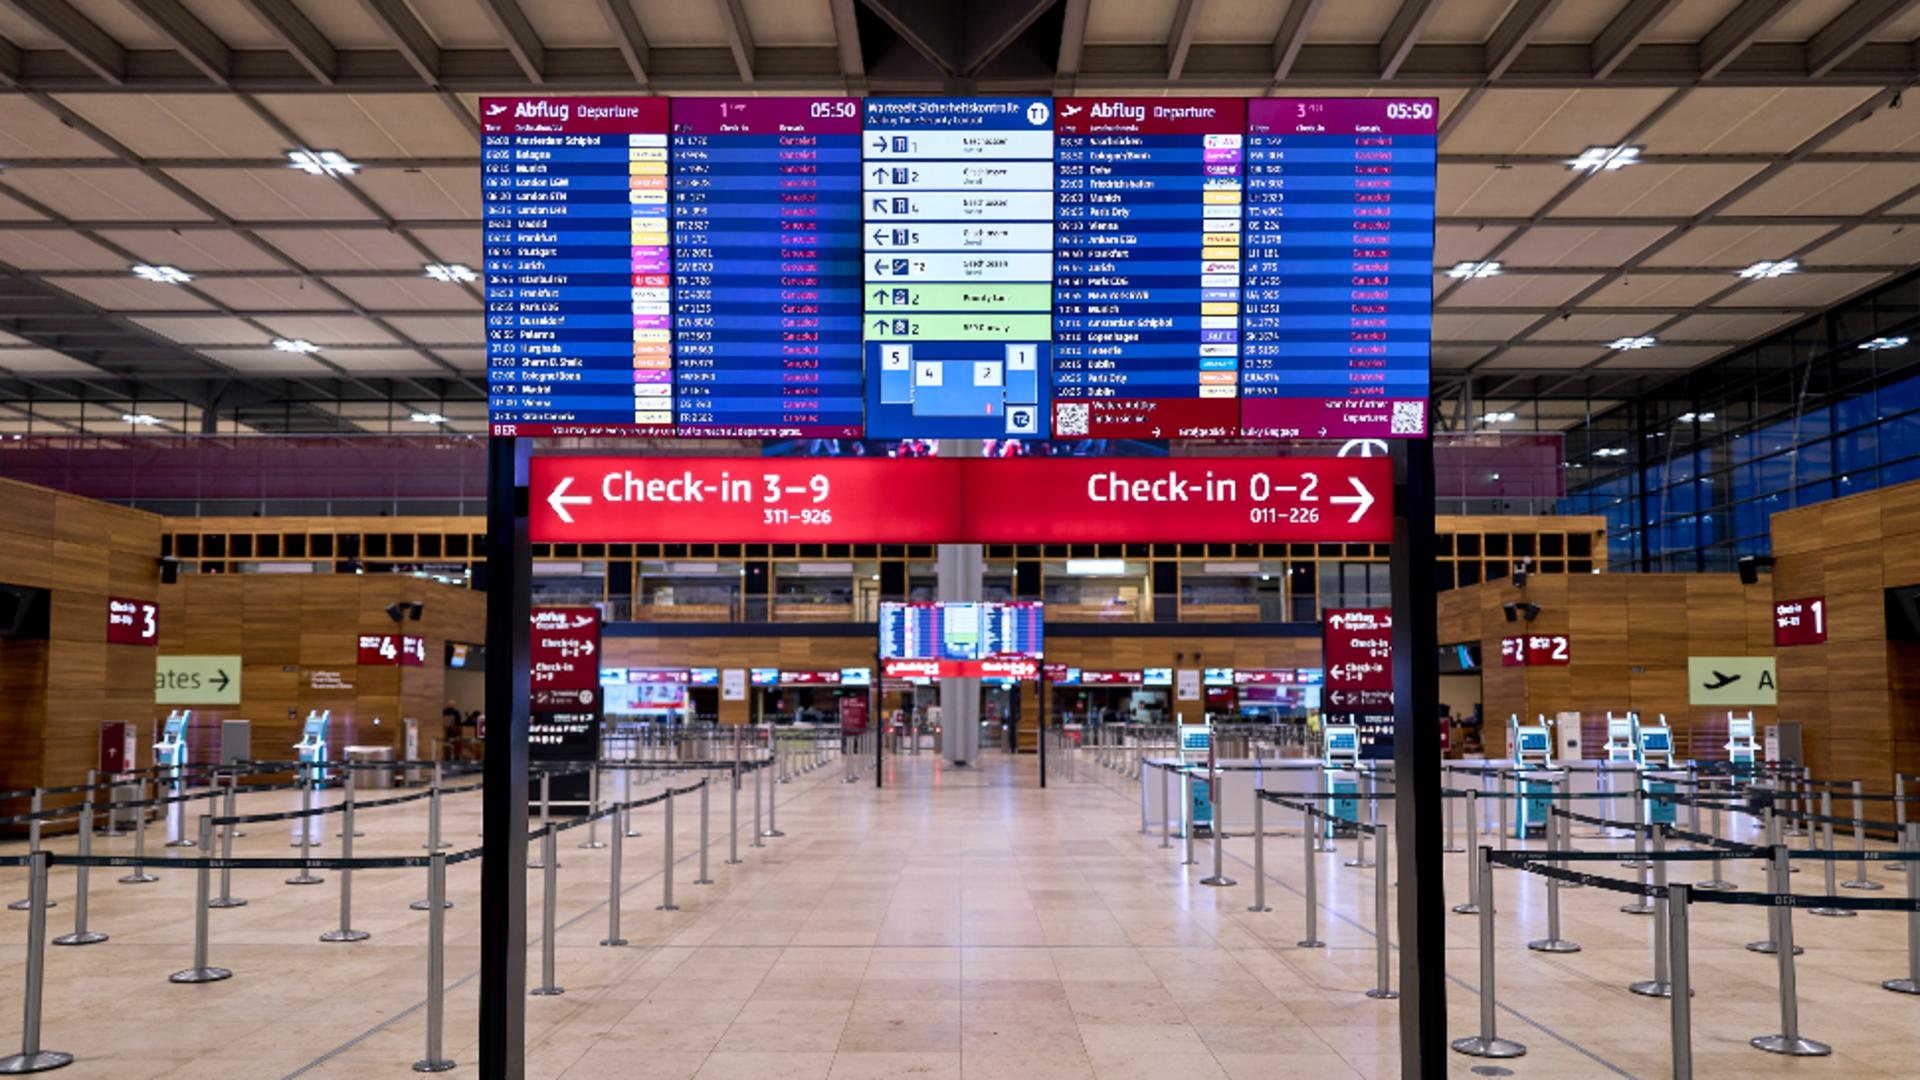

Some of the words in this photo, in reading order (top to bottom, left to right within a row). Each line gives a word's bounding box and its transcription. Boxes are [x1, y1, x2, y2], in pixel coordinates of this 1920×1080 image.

[514, 102, 569, 121] Abflug
[576, 106, 640, 119] Departure
[811, 103, 856, 118] 05:50
[1090, 103, 1145, 121] Abflug
[1153, 107, 1216, 120] Departure
[1387, 104, 1432, 119] 05:50
[515, 136, 562, 145] Amsterdam
[566, 136, 600, 147] Schiphol
[516, 164, 547, 173] Munich
[516, 178, 548, 187] London
[912, 171, 920, 184] 2
[516, 191, 548, 200] London
[1090, 193, 1120, 202] Munich
[518, 205, 548, 214] London
[518, 219, 547, 228] Madrid
[518, 233, 557, 242] Frankfurt
[912, 232, 920, 244] 5
[912, 294, 920, 305] 2
[1137, 318, 1172, 329] Schiphol
[912, 324, 920, 335] 2
[1088, 332, 1138, 343] Copenhagen
[891, 352, 900, 366] 5
[1018, 351, 1025, 365] 1
[1088, 359, 1115, 368] Dublin
[925, 367, 933, 378] 4
[983, 368, 992, 379] 2
[522, 385, 551, 394] Madrid
[1088, 387, 1115, 396] Dublin
[494, 425, 517, 435] BER
[602, 471, 751, 503] Check-in
[763, 474, 829, 502] 3–9
[1086, 471, 1235, 503] Check-in
[1249, 473, 1318, 502] 0–2
[763, 509, 832, 524] 311–926
[1249, 508, 1318, 523] 011–226
[142, 604, 156, 638] 3
[1811, 600, 1823, 634] 1
[380, 637, 398, 660] 4
[1552, 637, 1569, 660] 2
[1758, 670, 1775, 690] A
